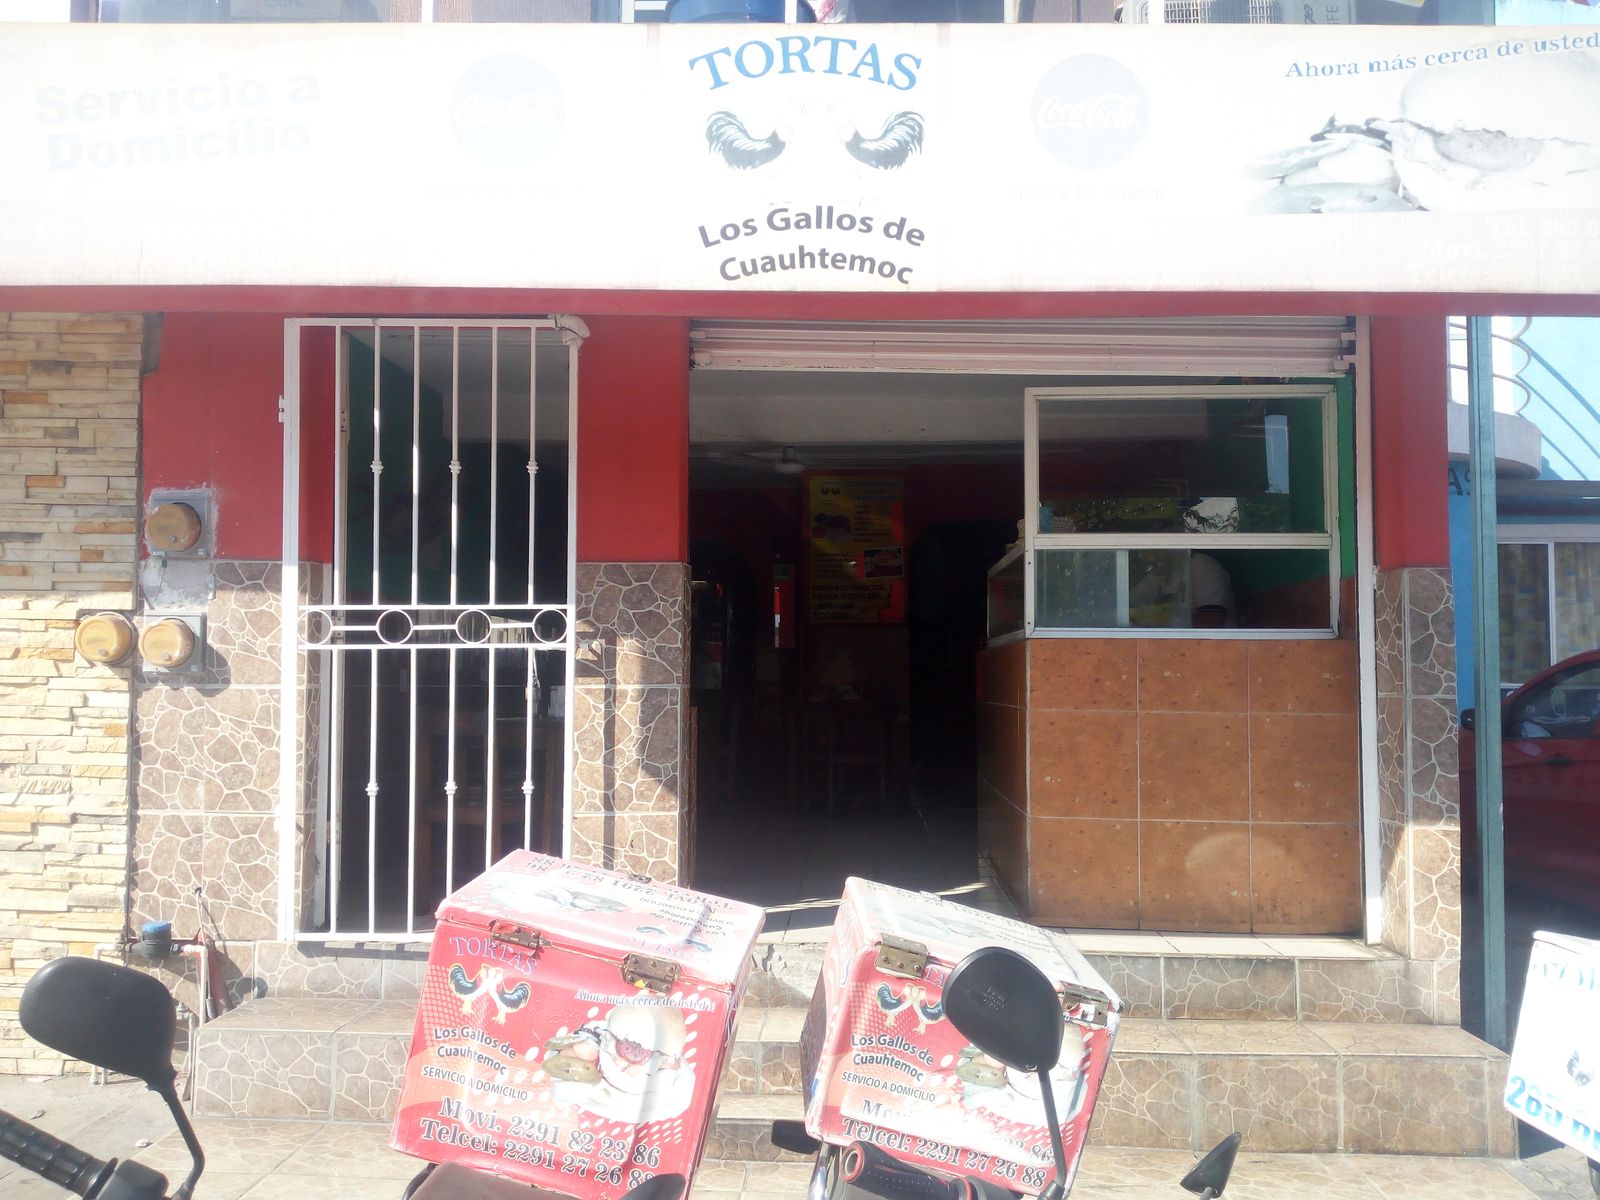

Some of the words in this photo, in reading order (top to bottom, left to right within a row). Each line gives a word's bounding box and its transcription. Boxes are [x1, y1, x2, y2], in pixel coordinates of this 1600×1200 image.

[688, 35, 922, 91] TORTAS
[1285, 61, 1360, 78] Ahora
[1368, 54, 1417, 73] más
[1424, 46, 1488, 67] cerca
[1496, 40, 1524, 57] de
[1533, 32, 1600, 53] usted
[35, 72, 268, 126] Servicio
[288, 74, 320, 104] a
[49, 116, 312, 172] Domicilio
[1104, 185, 1168, 201] SABOR
[698, 217, 758, 248] Los
[766, 205, 873, 234] Gallos
[883, 217, 925, 247] de
[719, 245, 913, 285] Cuauhtemoc
[434, 1028, 458, 1040] Los
[461, 1026, 499, 1049] Gallos
[500, 1041, 517, 1059] de
[437, 1045, 508, 1075] Cuauhtemoc
[851, 1034, 874, 1046] Los
[877, 1033, 917, 1054] Gallos
[918, 1048, 934, 1066] de
[423, 1066, 466, 1084] SERVICIO
[475, 1080, 529, 1101] DOMICILIO
[842, 1071, 881, 1088] SERVICIO
[881, 1081, 889, 1091] A
[889, 1083, 936, 1103] DOMICILIO
[853, 1053, 924, 1082] Cuauhtemoc
[420, 1119, 498, 1155] Telcel:
[503, 1141, 555, 1168] 2291
[562, 1155, 590, 1177] 27
[595, 1163, 622, 1185] 26
[439, 1097, 502, 1132] Movi.
[508, 1116, 560, 1146] 2291
[567, 1129, 594, 1153] 82
[599, 1137, 627, 1161] 23
[633, 1144, 661, 1168] 86
[843, 1118, 912, 1151] Telcel:
[915, 1137, 961, 1165] 2291
[965, 1151, 991, 1171] 27
[992, 1158, 1018, 1179] 26
[1021, 1166, 1046, 1188] 88
